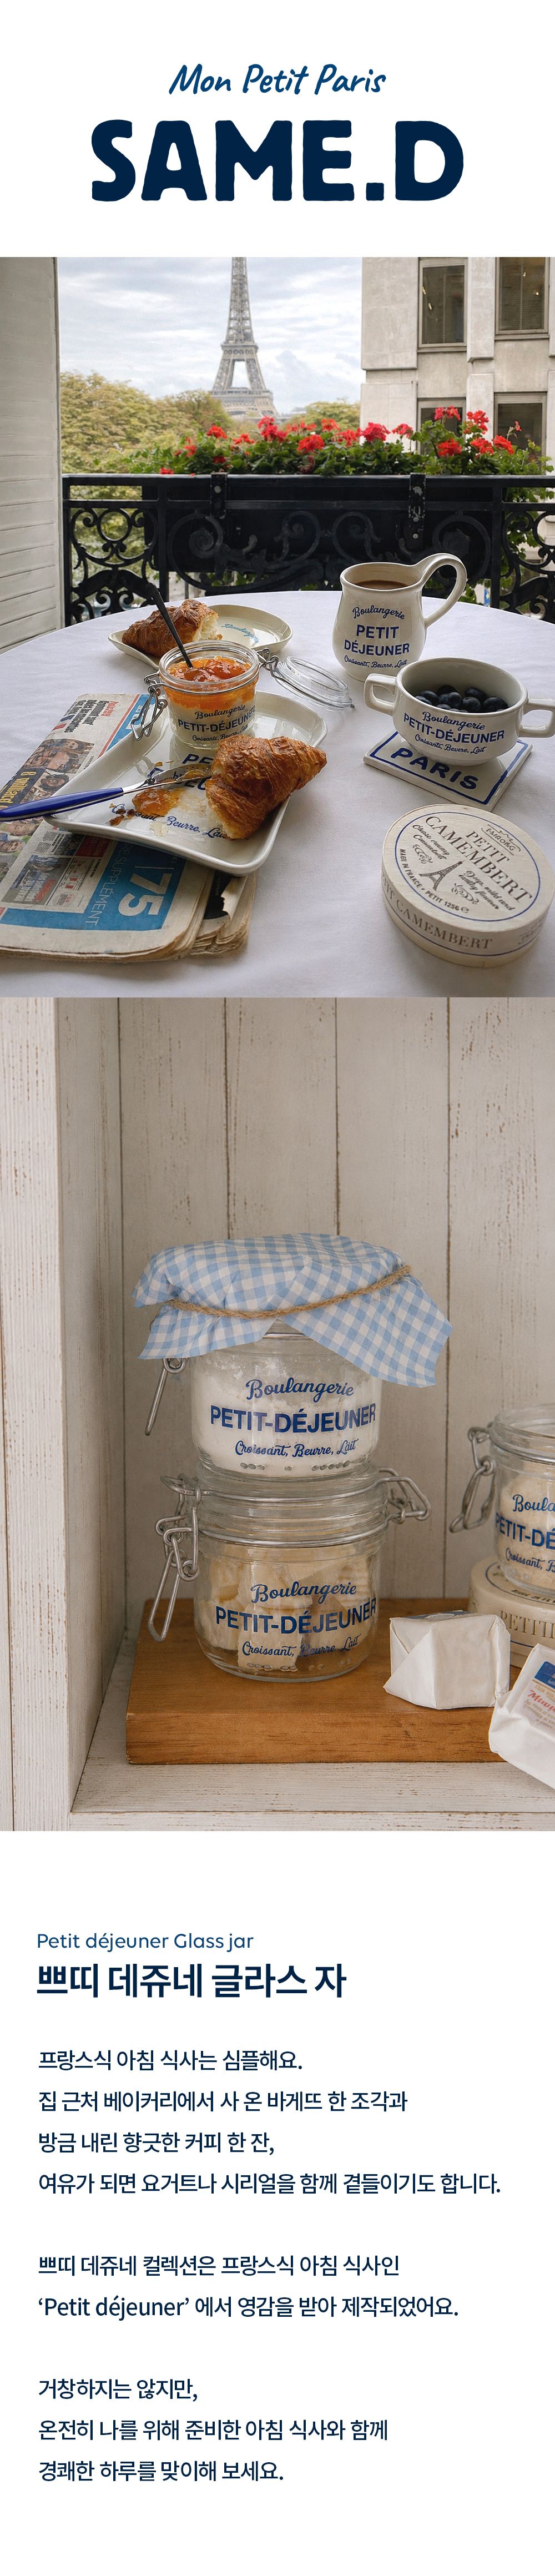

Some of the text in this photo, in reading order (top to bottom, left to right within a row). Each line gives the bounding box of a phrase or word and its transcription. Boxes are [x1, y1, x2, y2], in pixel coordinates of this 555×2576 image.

[352, 604, 405, 619] Boulangerie
[356, 624, 399, 639] PETIT
[344, 639, 410, 656] DÉJEUNER
[195, 705, 246, 719] Boulangerie
[422, 711, 486, 731] Boulangerie
[403, 712, 505, 744] PETIT-DÉJEUNER
[390, 747, 479, 789] PARIS
[466, 830, 509, 863] PETIT
[425, 816, 533, 903] CAMEMBERT
[85, 856, 127, 926] SUPPLÉMENT
[118, 873, 173, 917] 75
[425, 890, 443, 904] PETIT
[396, 899, 493, 950] CAMEMBERT
[245, 1377, 354, 1403] Boulangerie
[210, 1403, 376, 1433] PETIT-DÉJEUNER
[235, 1438, 360, 1458] Croissant, Beurre, Lait
[505, 1547, 546, 1570] Croissant,
[250, 1581, 357, 1604] Boulangerie
[216, 1597, 377, 1634] PETIT-DÉJEUNER
[242, 1641, 296, 1657] Croissant,
[340, 1634, 362, 1651] Lait
